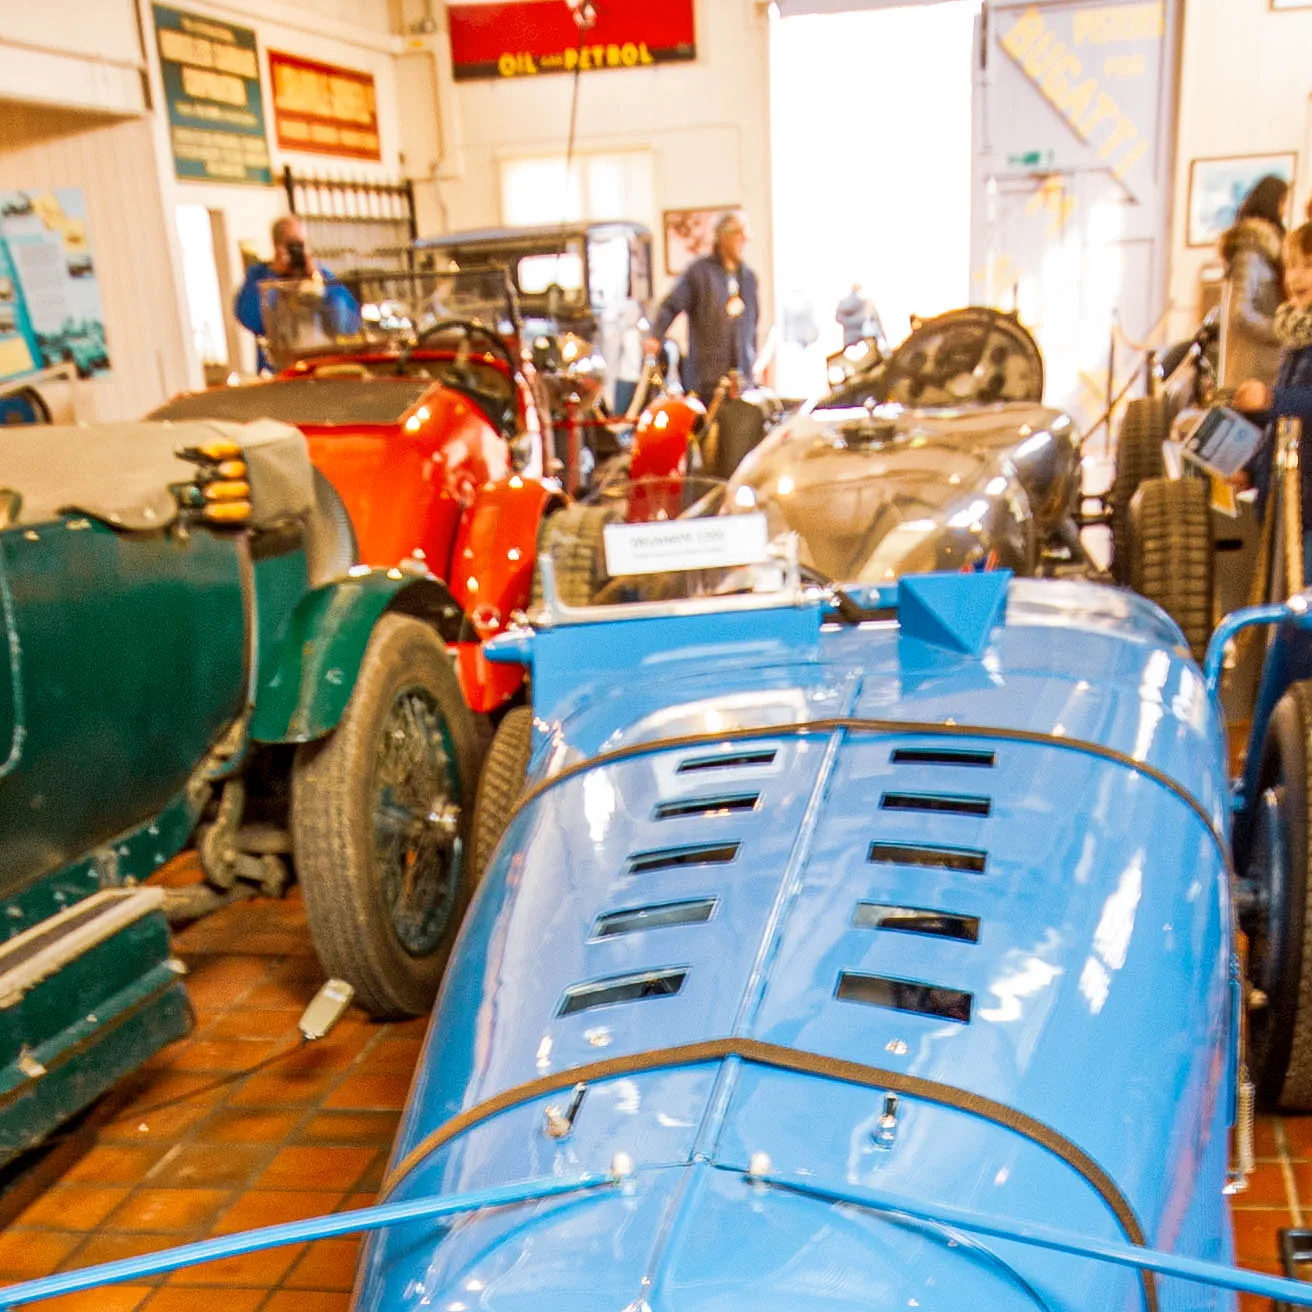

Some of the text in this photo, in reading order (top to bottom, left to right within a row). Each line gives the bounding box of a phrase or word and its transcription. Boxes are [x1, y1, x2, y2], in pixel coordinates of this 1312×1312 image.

[498, 52, 537, 77] OIL
[564, 42, 654, 71] PETROL
[1002, 4, 1150, 179] BUGATTI
